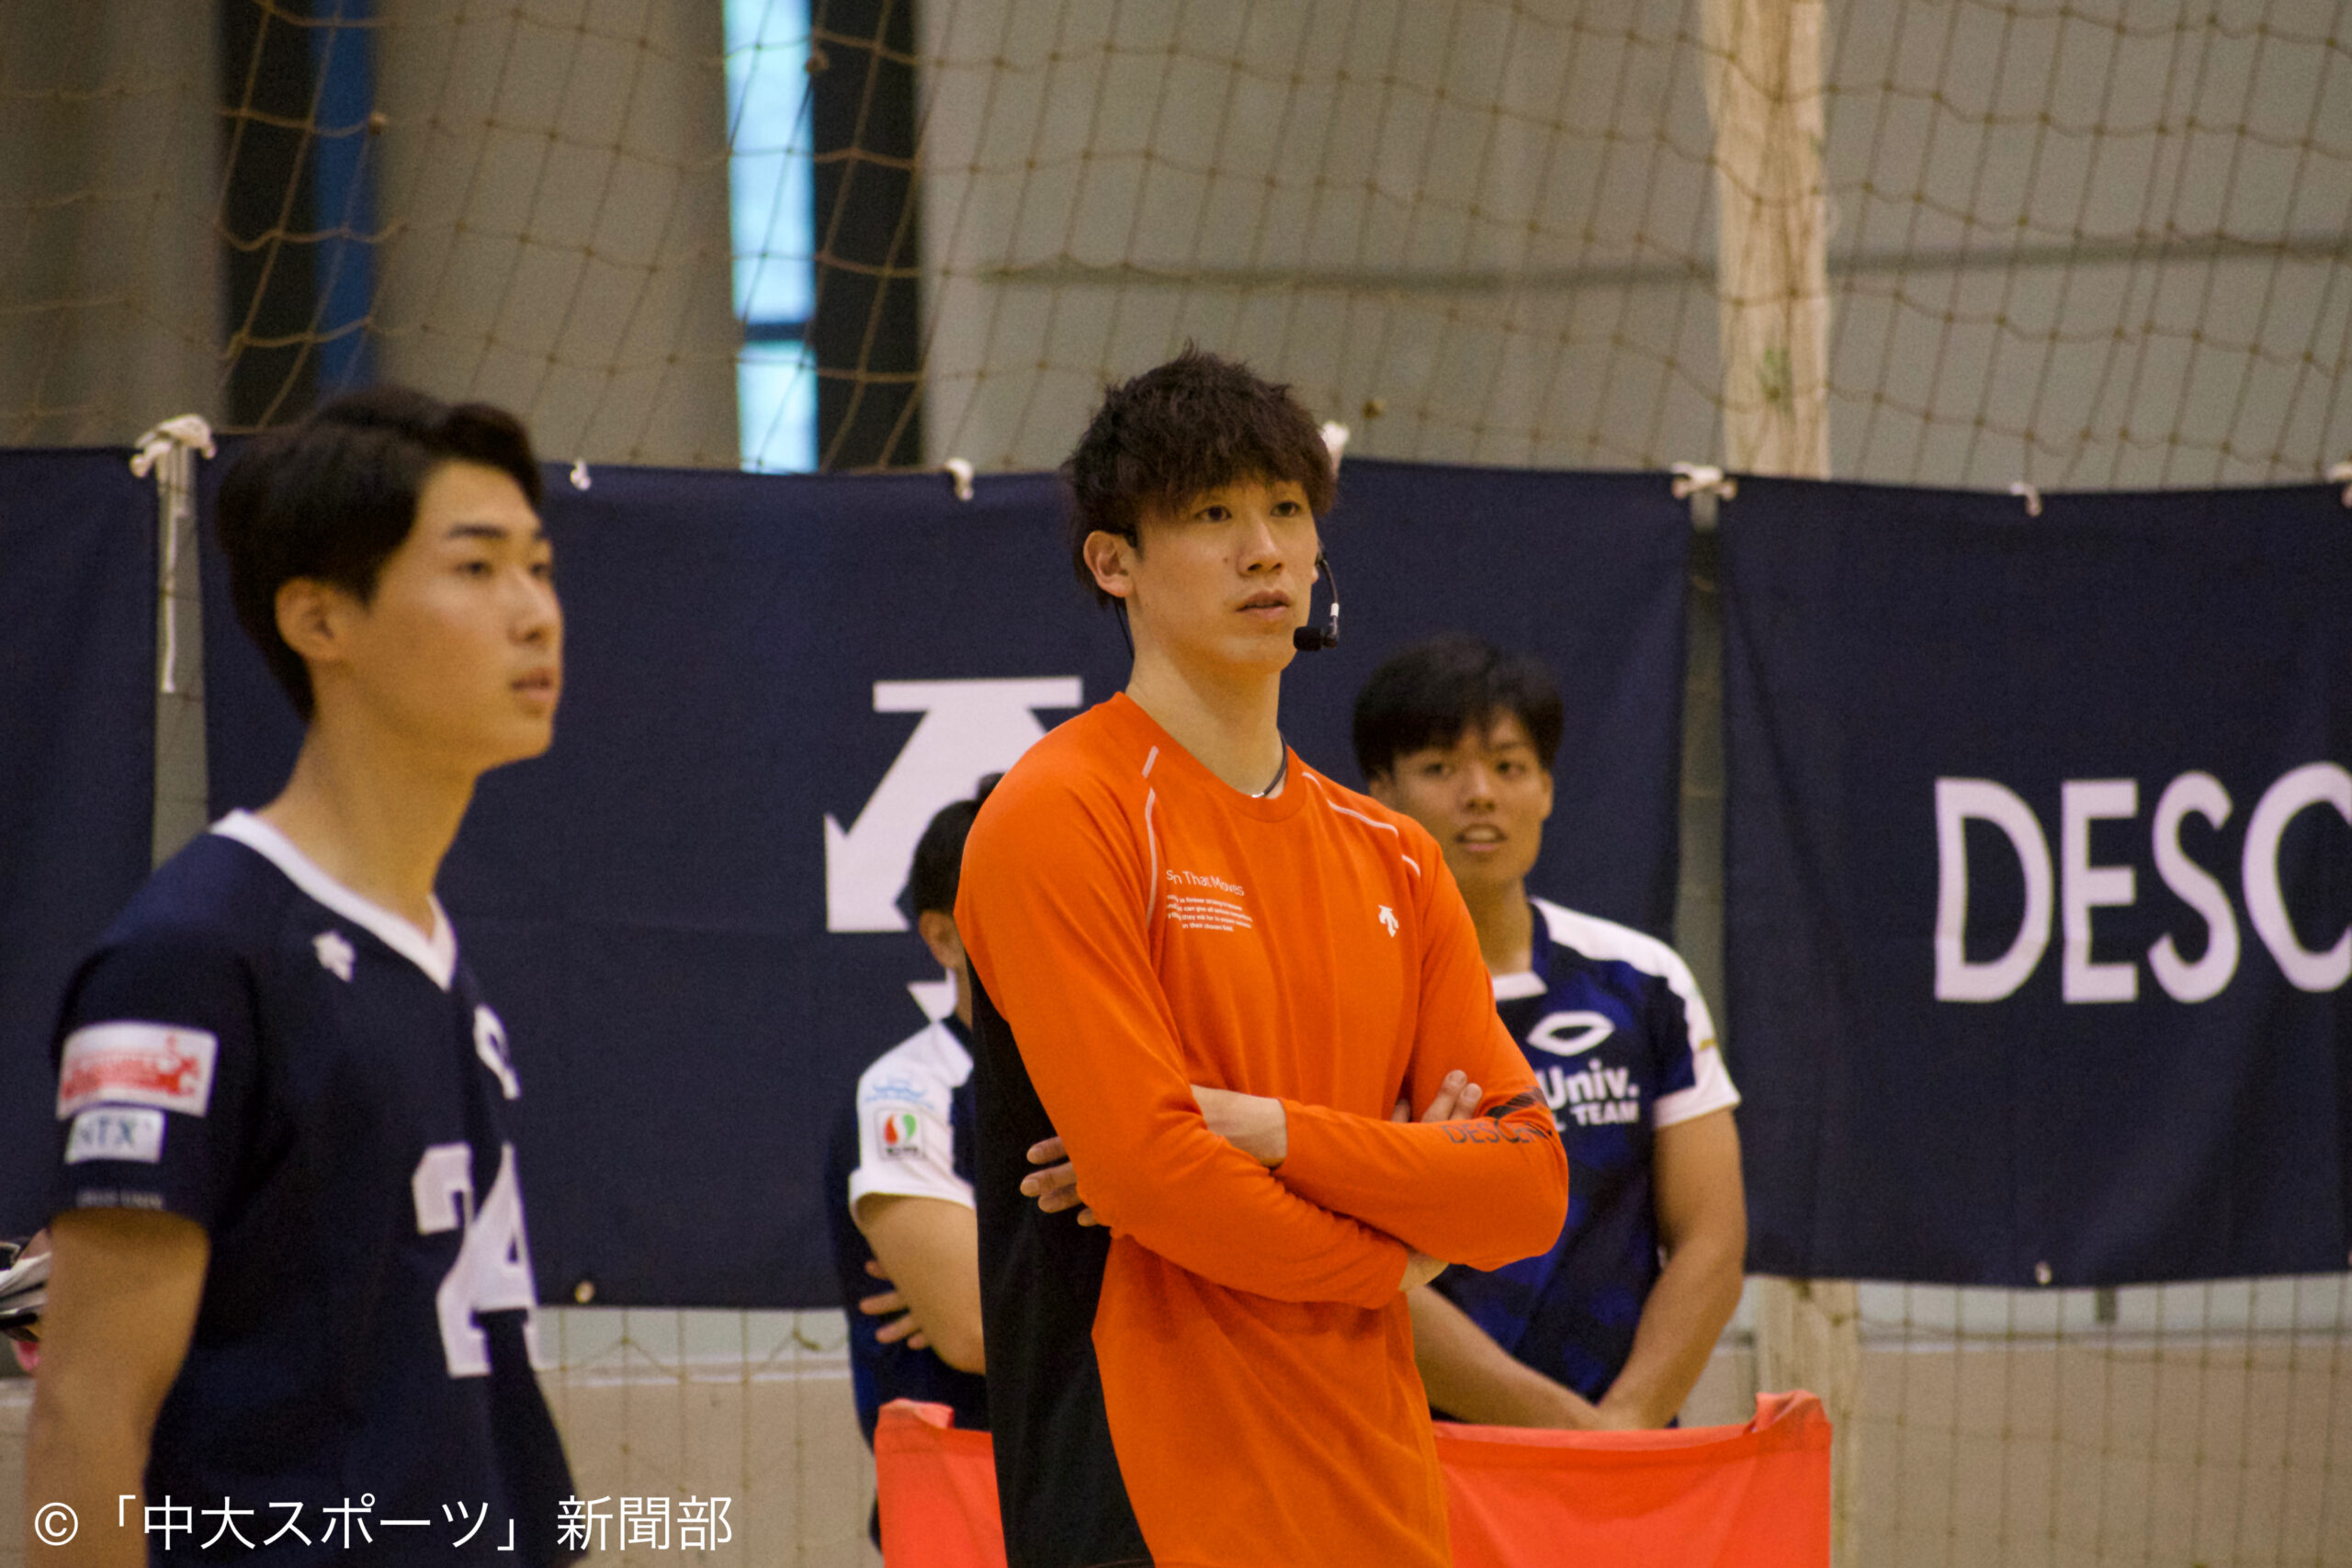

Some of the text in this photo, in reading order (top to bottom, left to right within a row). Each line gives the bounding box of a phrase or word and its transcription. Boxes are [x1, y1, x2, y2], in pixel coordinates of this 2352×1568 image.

[1934, 761, 2352, 1003] DESC
[1570, 1101, 1639, 1127] TEAM
[412, 1141, 543, 1376] 24
